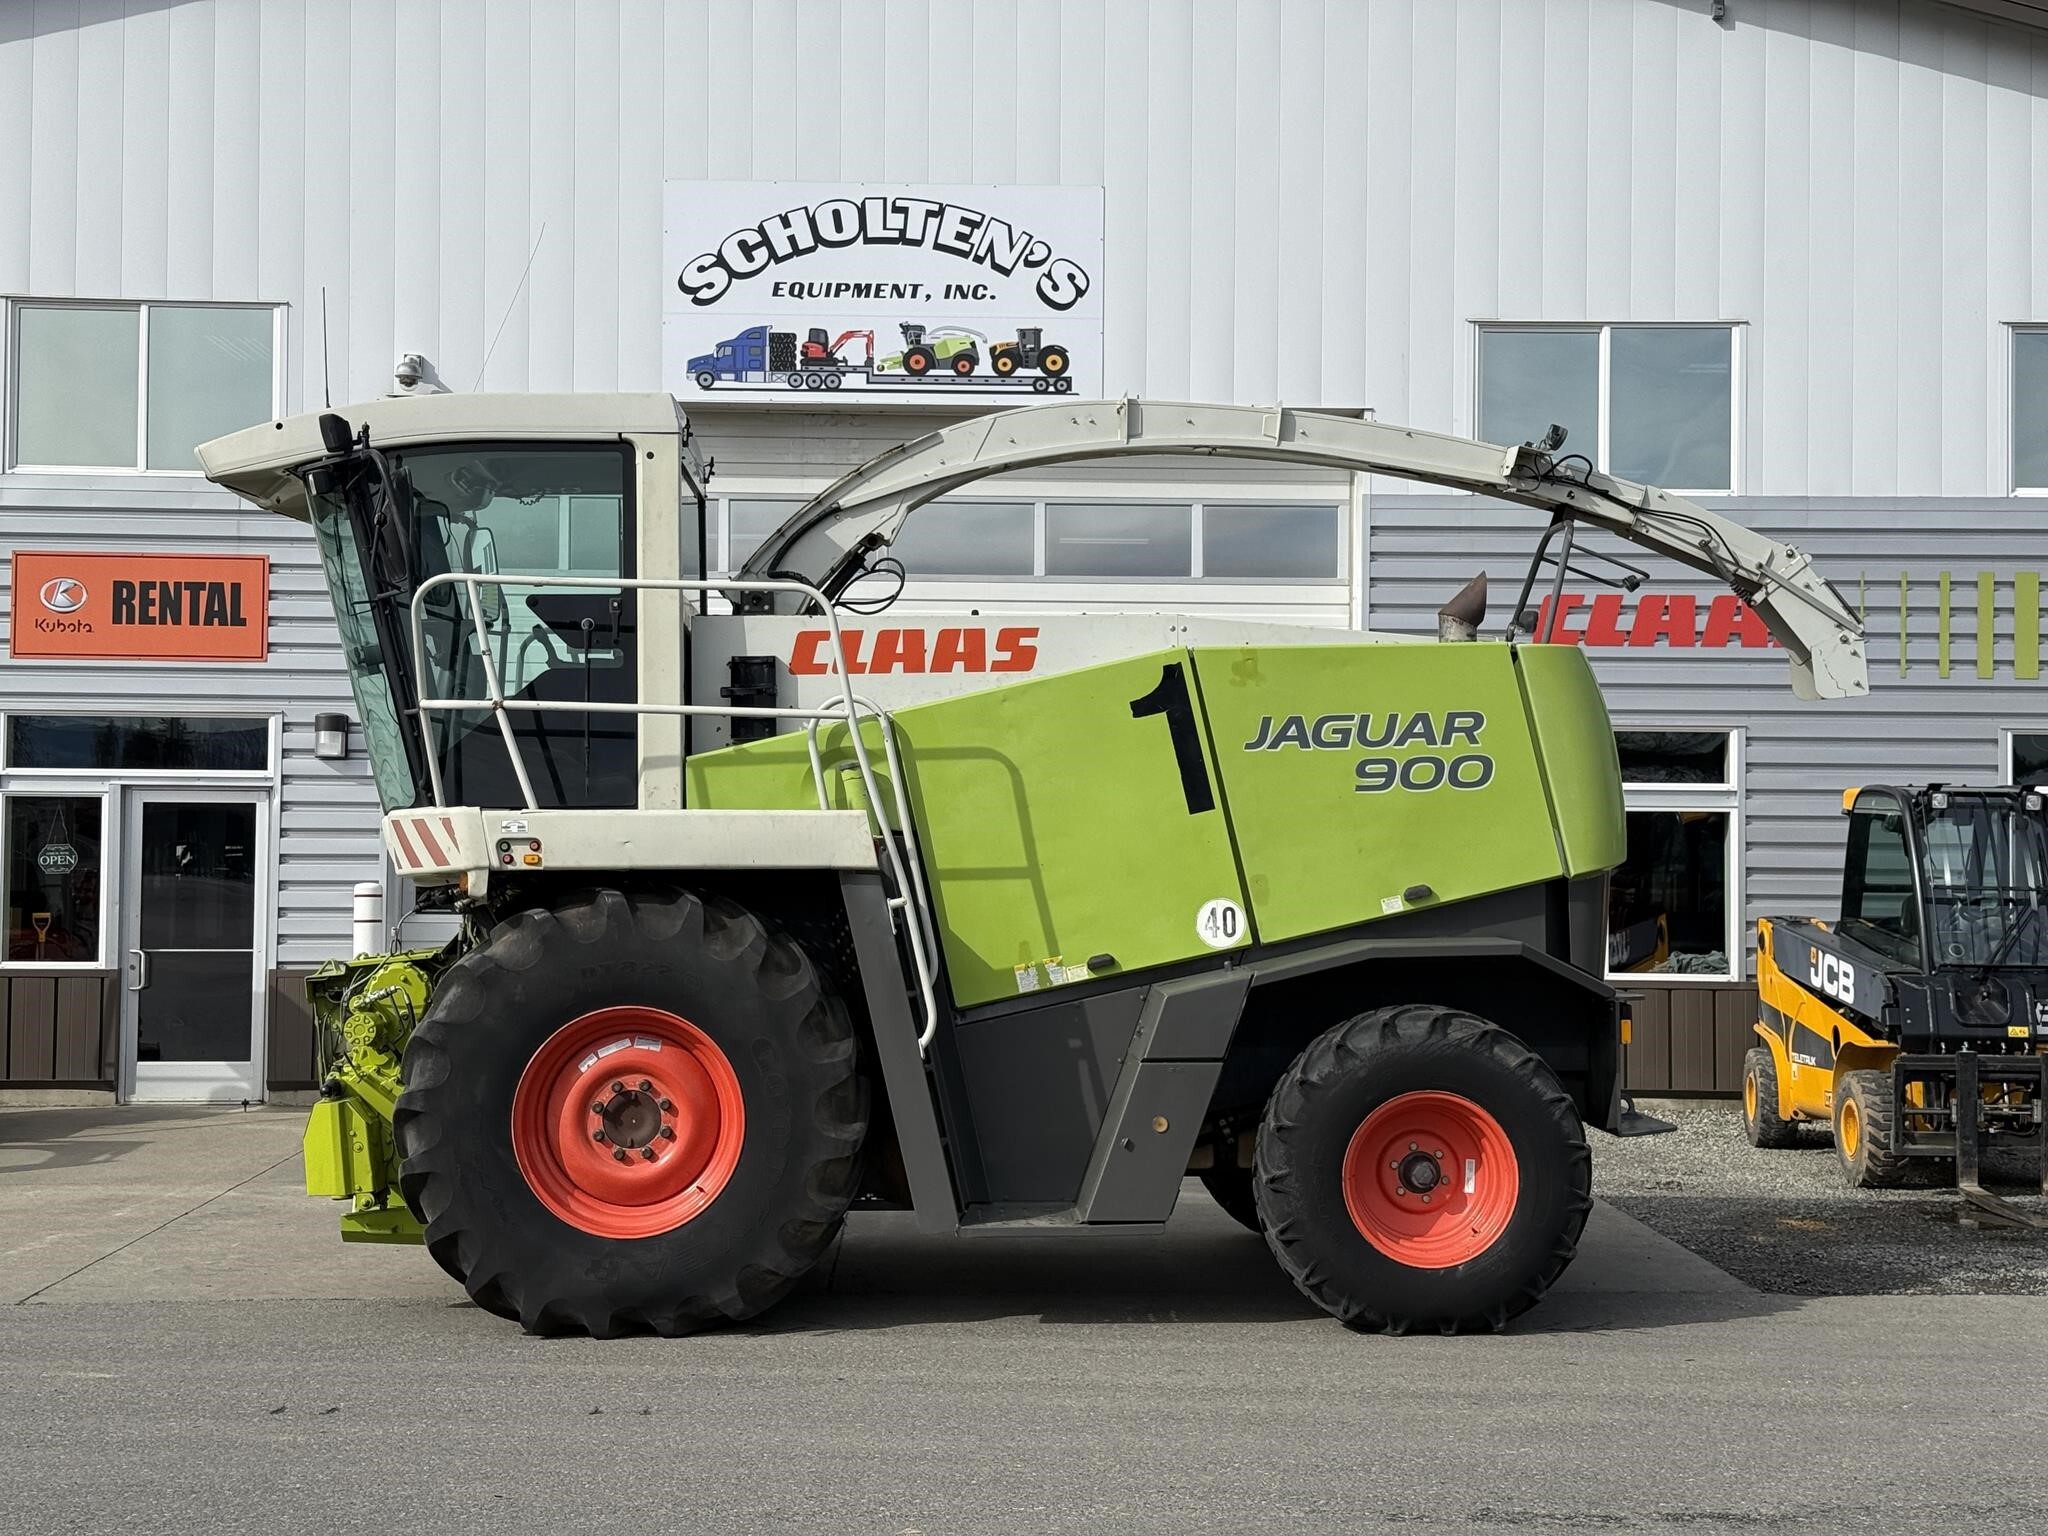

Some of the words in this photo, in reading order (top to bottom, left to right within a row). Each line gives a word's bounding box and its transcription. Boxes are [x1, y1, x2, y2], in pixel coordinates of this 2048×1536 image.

[678, 197, 1090, 311] SCHOLTEN'S
[771, 281, 932, 302] EQUIPMENT,
[943, 284, 998, 301] INC.
[35, 618, 94, 633] Kubota
[112, 580, 247, 627] RENTAL
[1533, 594, 1783, 648] CLAA
[788, 627, 1041, 676] CLAAS
[1130, 662, 1216, 815] 1
[1243, 710, 1486, 751] JAGUAR
[1354, 753, 1495, 794] 900
[40, 855, 75, 865] OPEN
[1205, 906, 1237, 938] 40
[1810, 949, 1855, 1004] JCB
